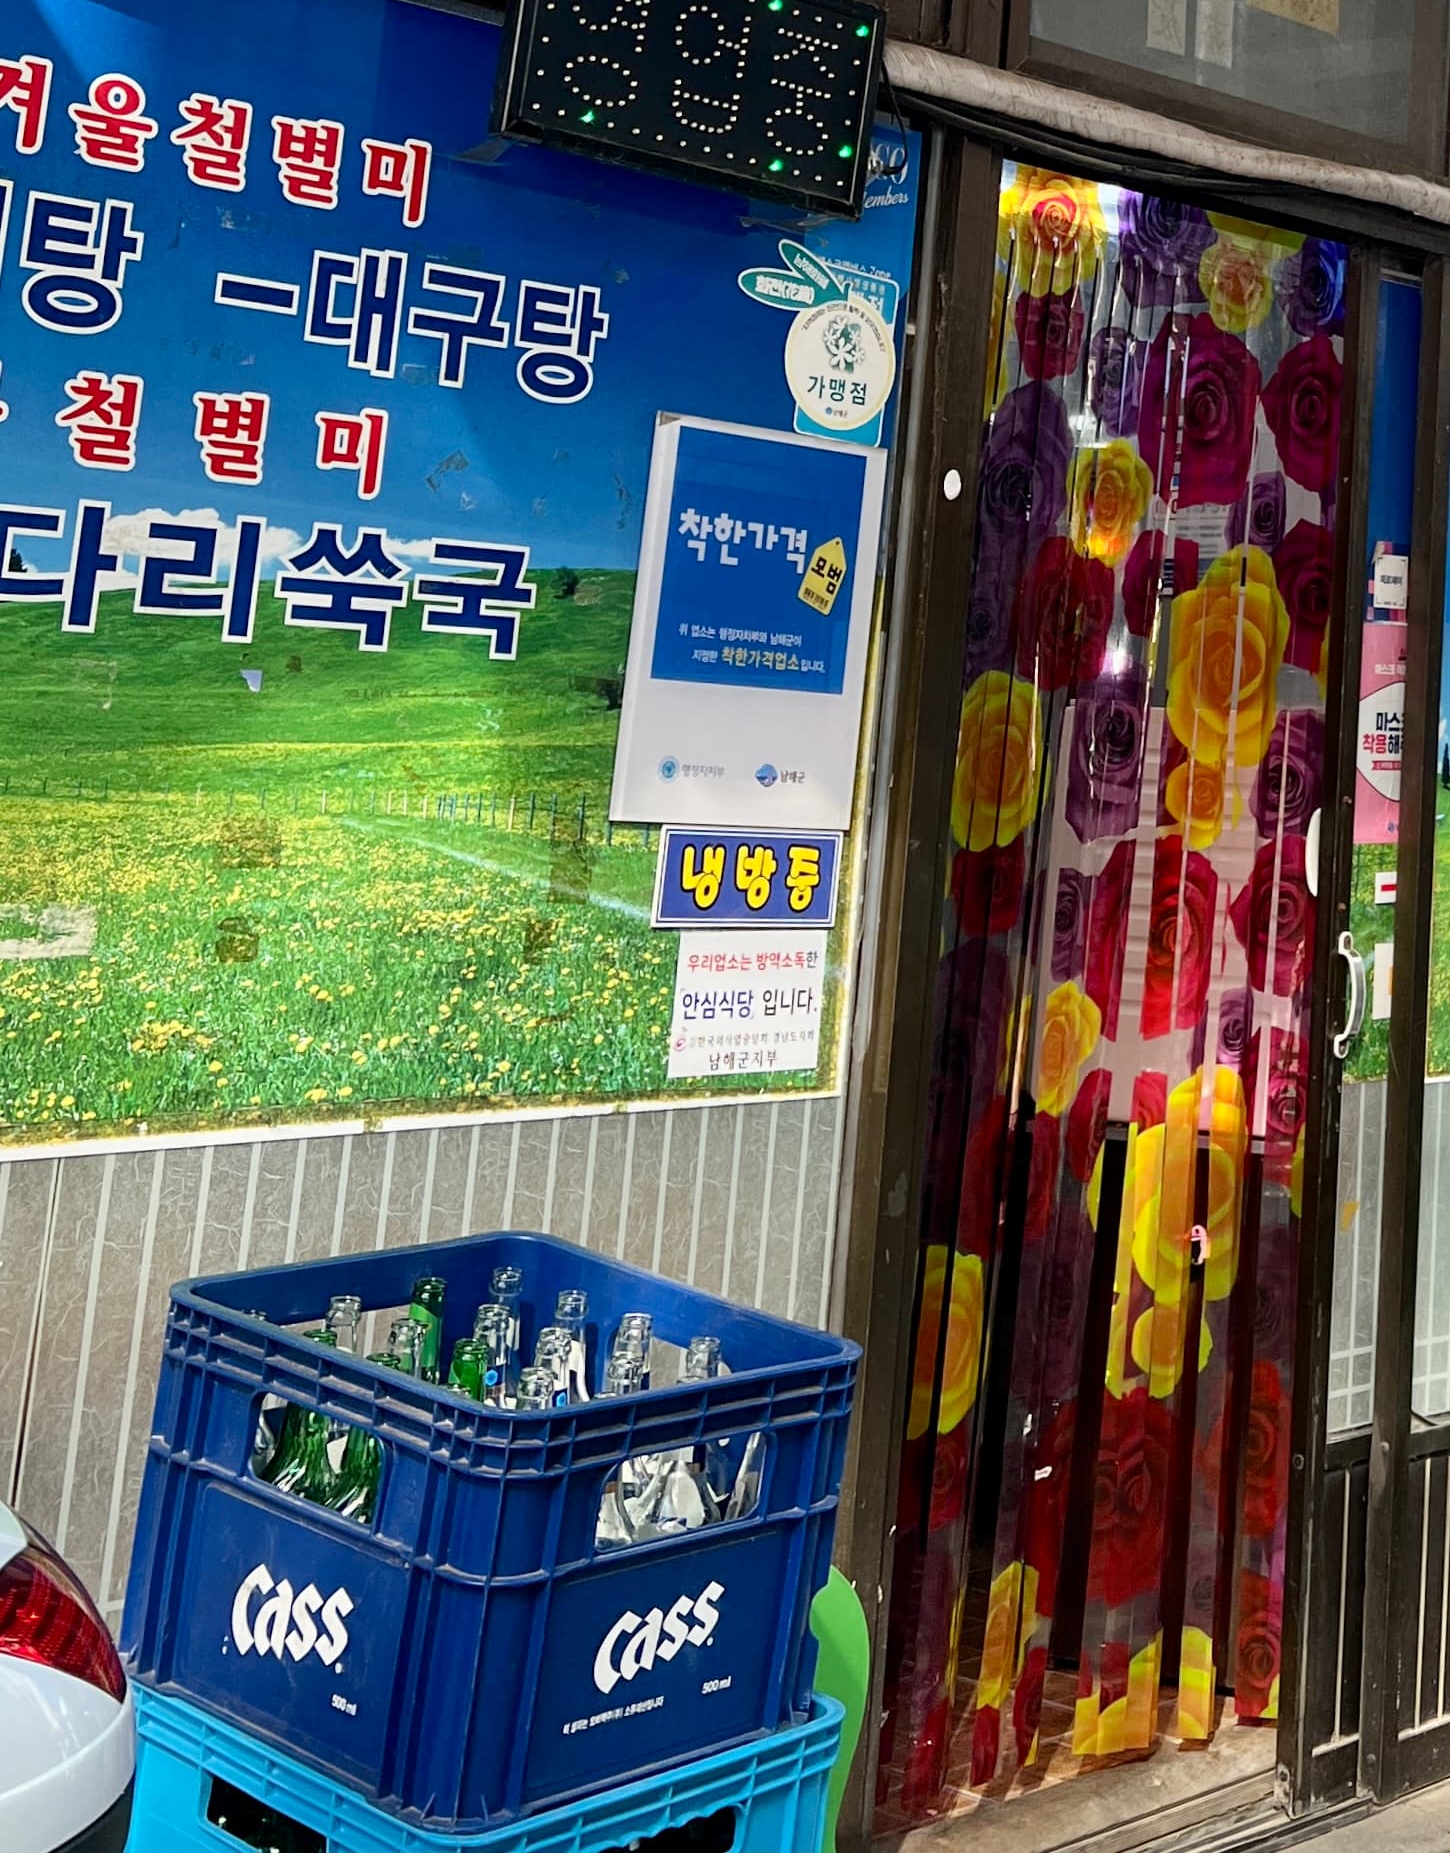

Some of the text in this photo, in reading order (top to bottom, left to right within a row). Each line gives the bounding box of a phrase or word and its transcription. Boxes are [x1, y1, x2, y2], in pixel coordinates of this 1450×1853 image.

[862, 185, 909, 209] embers
[0, 179, 145, 335] 탕
[806, 374, 868, 407] 가맹점
[677, 507, 808, 575] 착한가격
[810, 555, 844, 596] 모범
[1375, 710, 1403, 733] 마스
[780, 769, 807, 784] 남해군
[680, 843, 822, 913] 냉방중
[687, 951, 819, 973] 우리업소는 방역소독한
[762, 987, 818, 1016] 입니다.
[708, 1049, 778, 1072] 남해군지부
[231, 1563, 355, 1667] Cass
[593, 1581, 726, 1694] Cass
